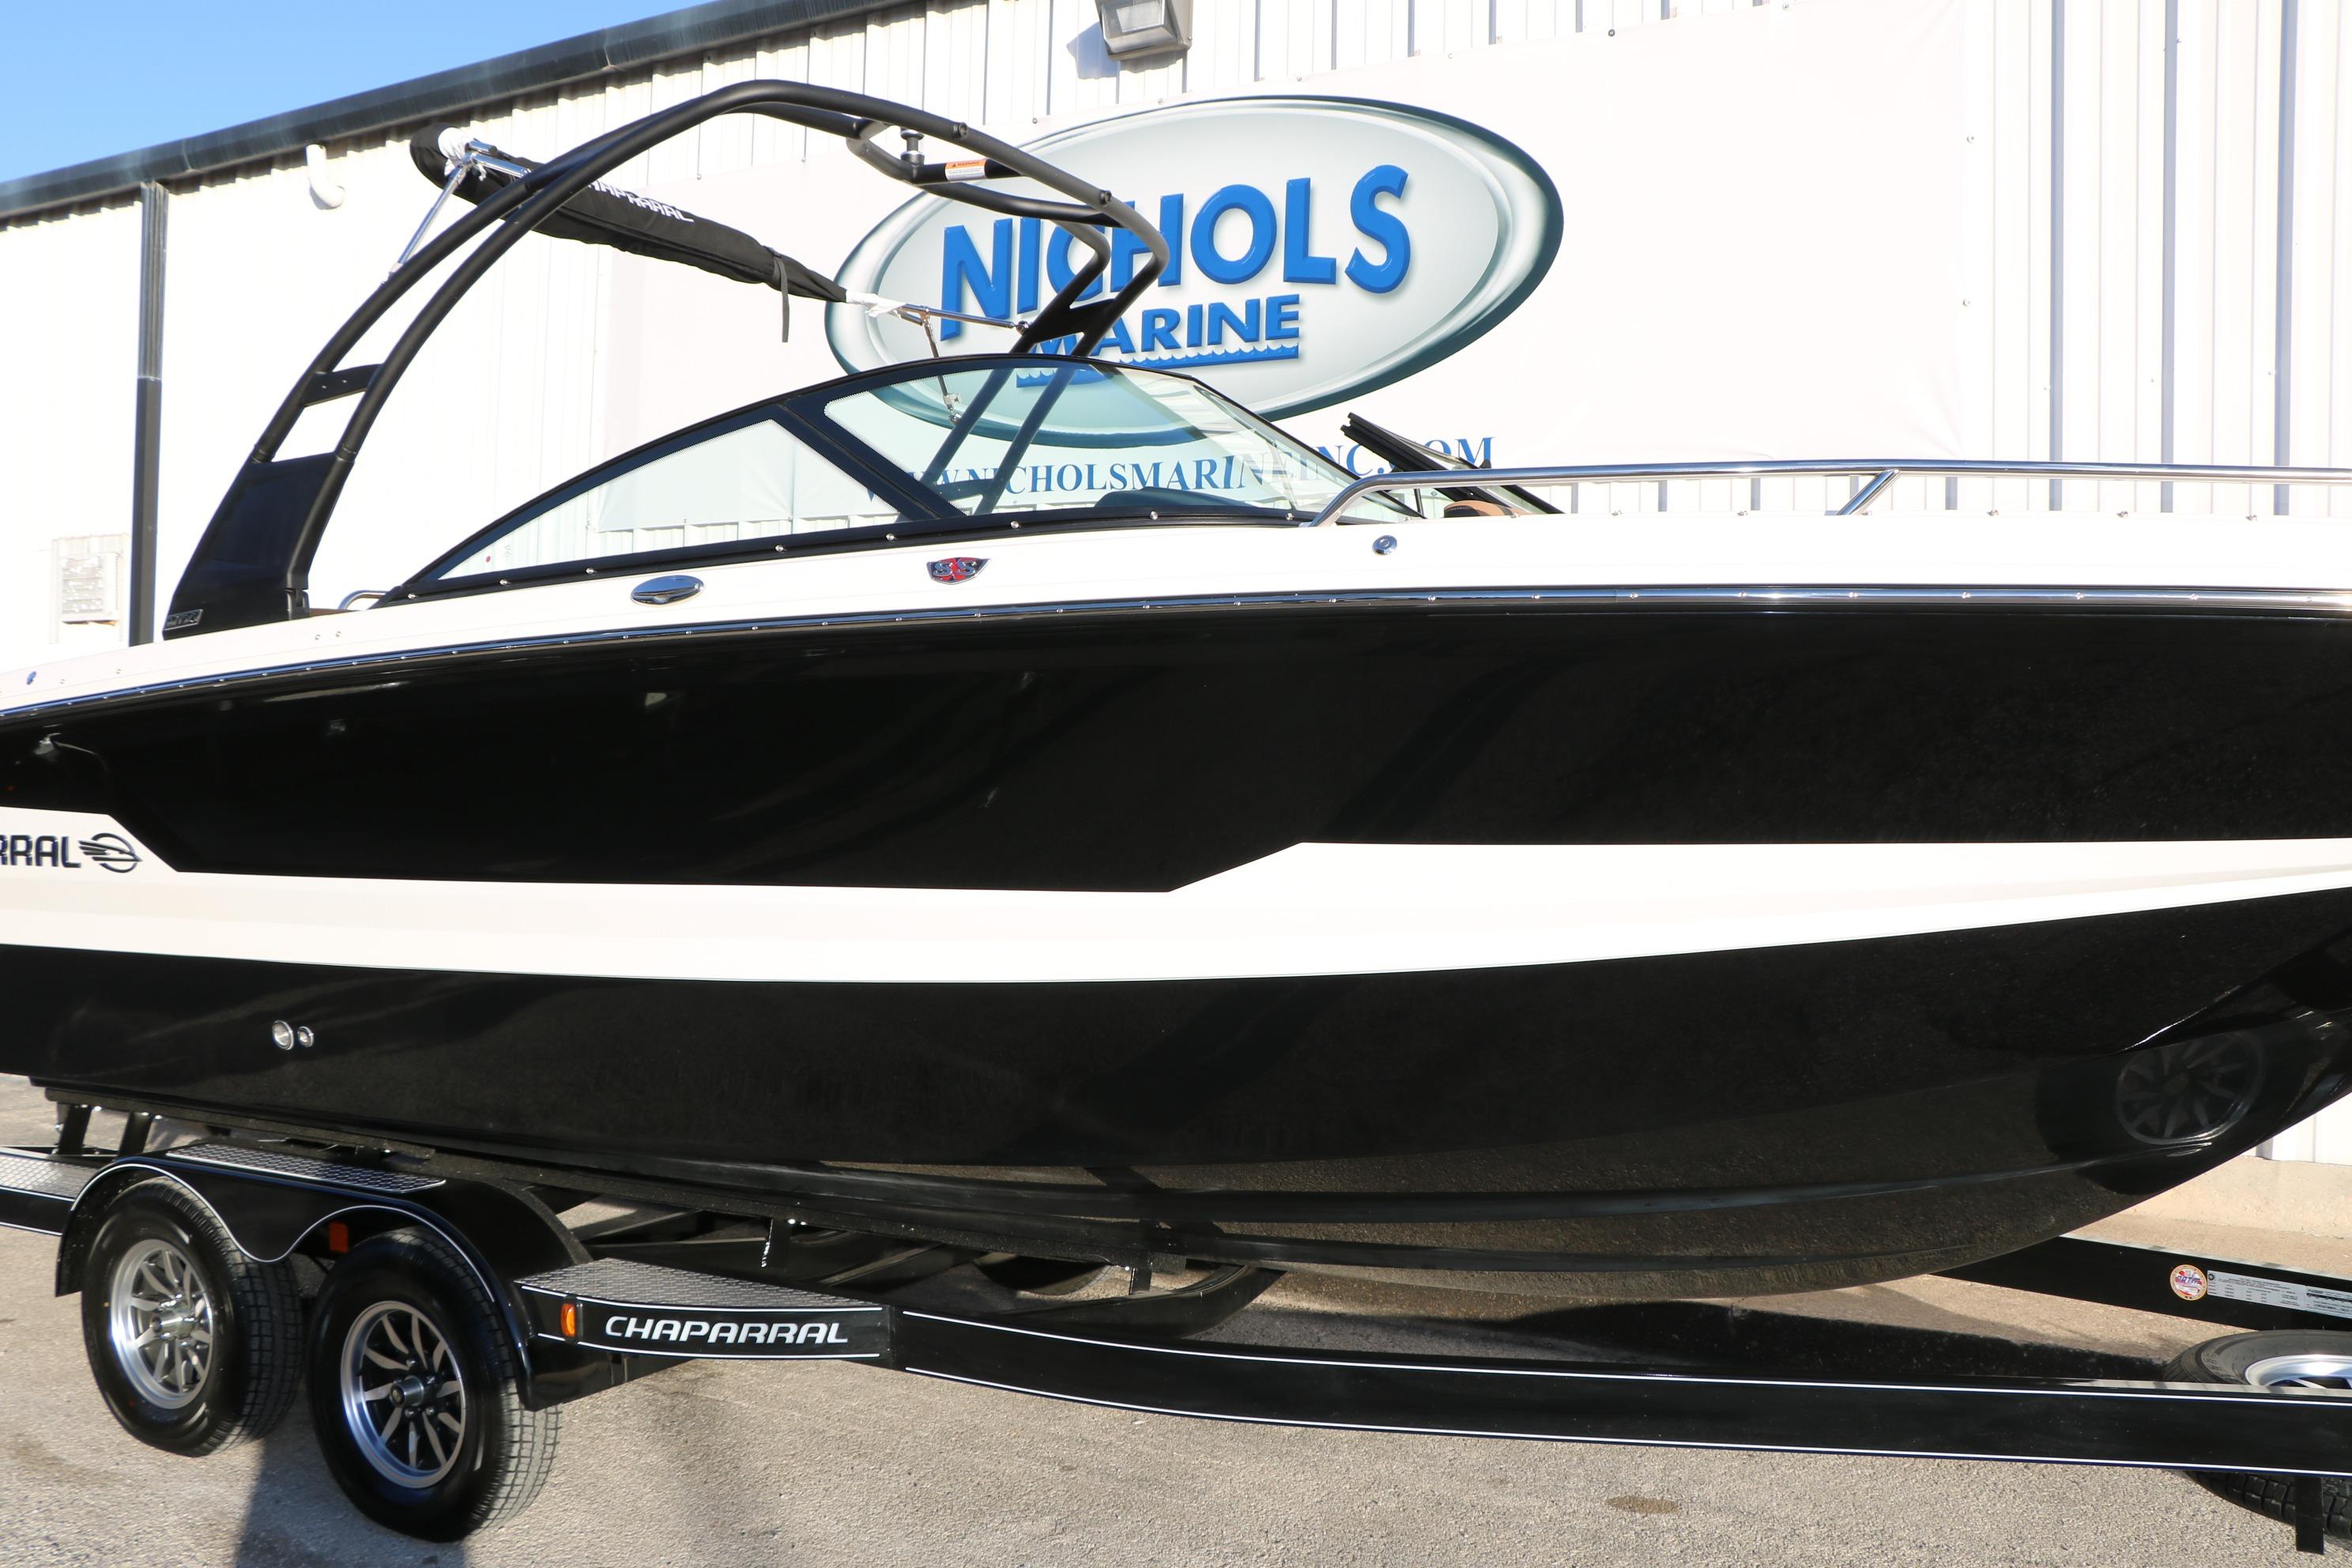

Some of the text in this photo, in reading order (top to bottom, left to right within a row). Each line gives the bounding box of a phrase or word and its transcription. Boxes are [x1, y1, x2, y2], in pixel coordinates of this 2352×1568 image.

[587, 180, 695, 223] HAPARRAL
[940, 164, 1411, 341] NICHOLS
[605, 1316, 849, 1344] CHAPARRAL
